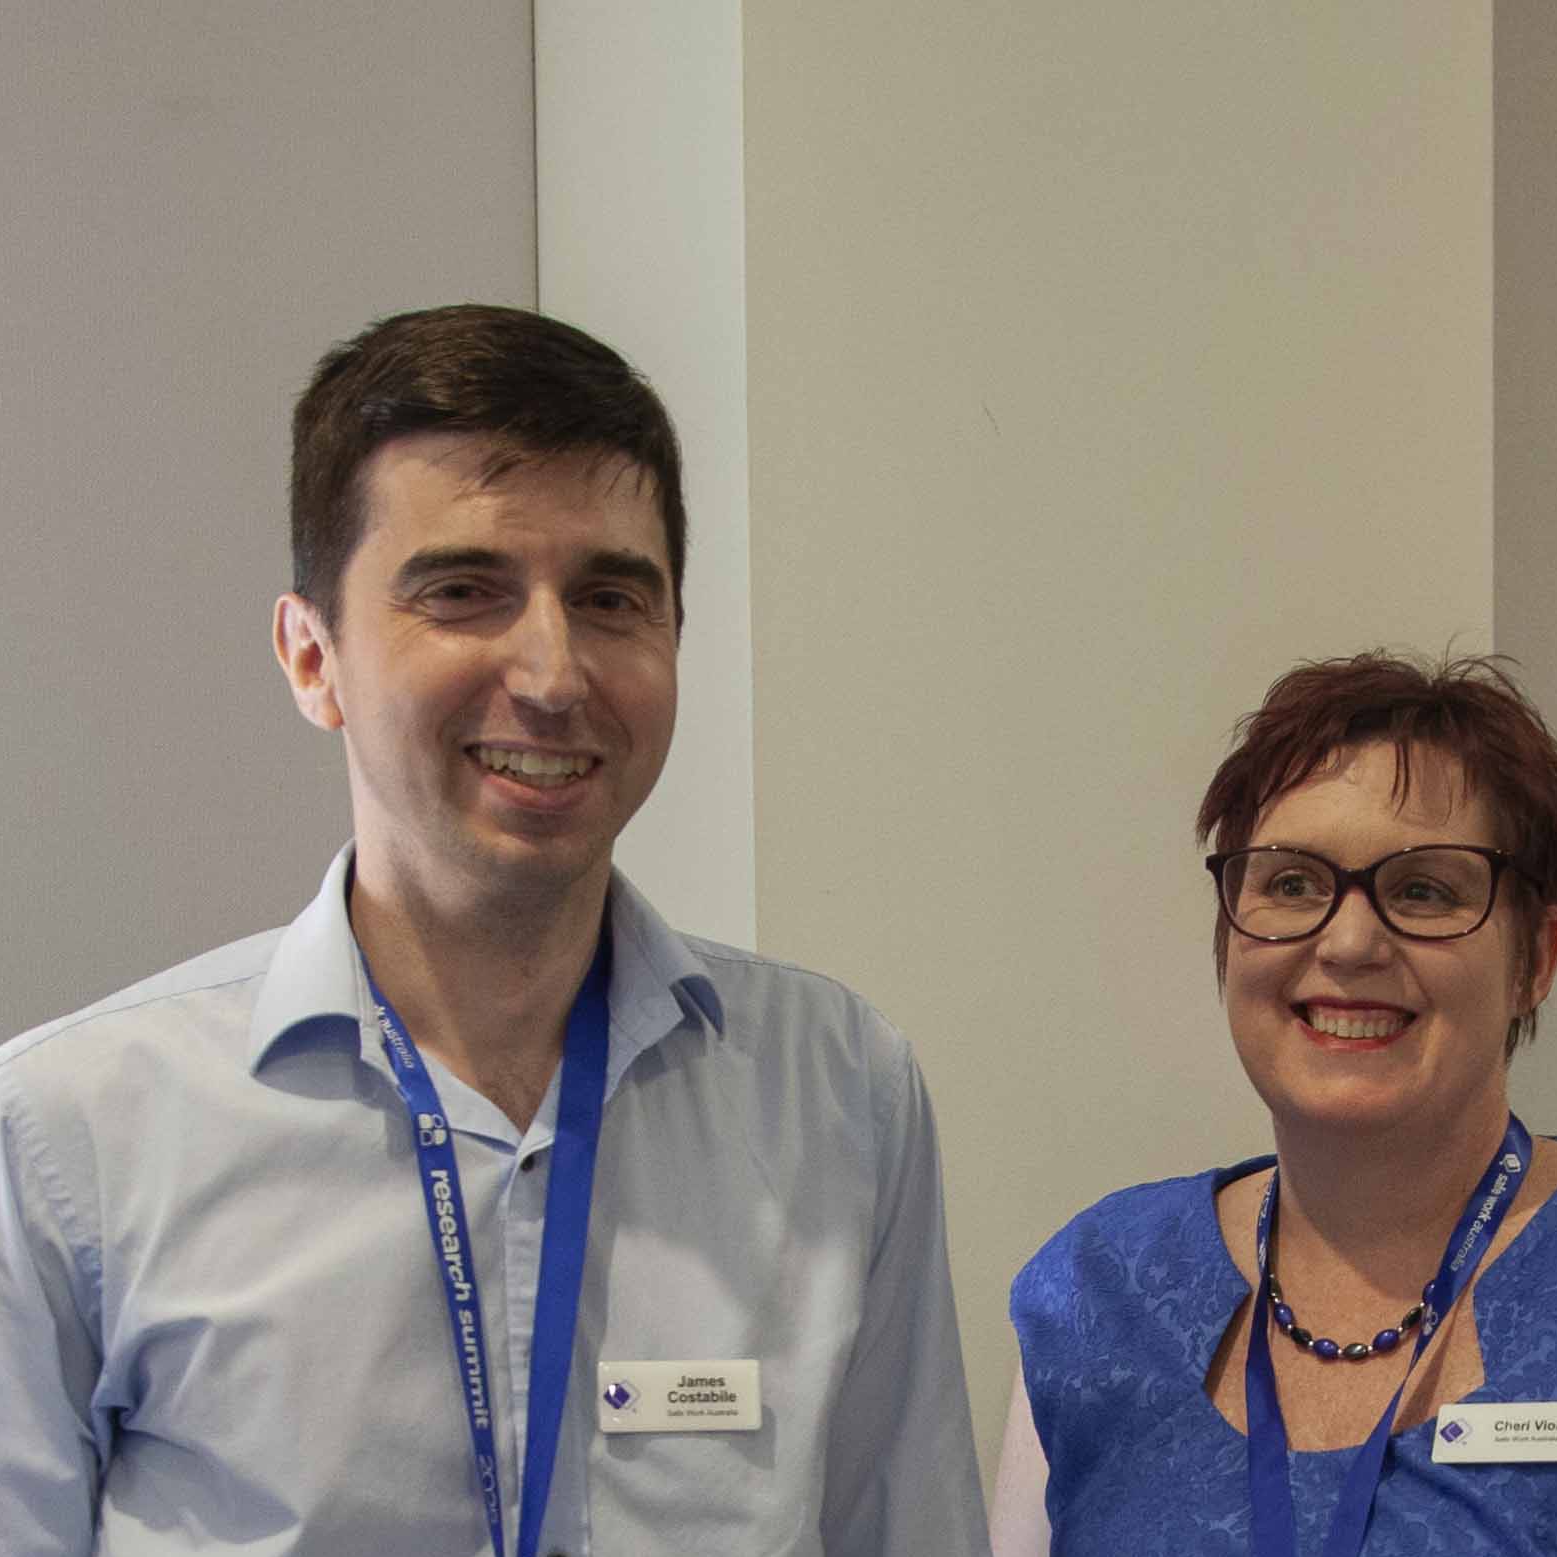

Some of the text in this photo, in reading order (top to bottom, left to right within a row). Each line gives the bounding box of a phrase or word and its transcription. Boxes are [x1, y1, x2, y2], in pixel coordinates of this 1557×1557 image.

[431, 1169, 471, 1303] research
[457, 1306, 489, 1429] summit
[677, 1375, 726, 1388] James
[667, 1391, 737, 1404] Costabile
[1494, 1420, 1531, 1432] Cheri
